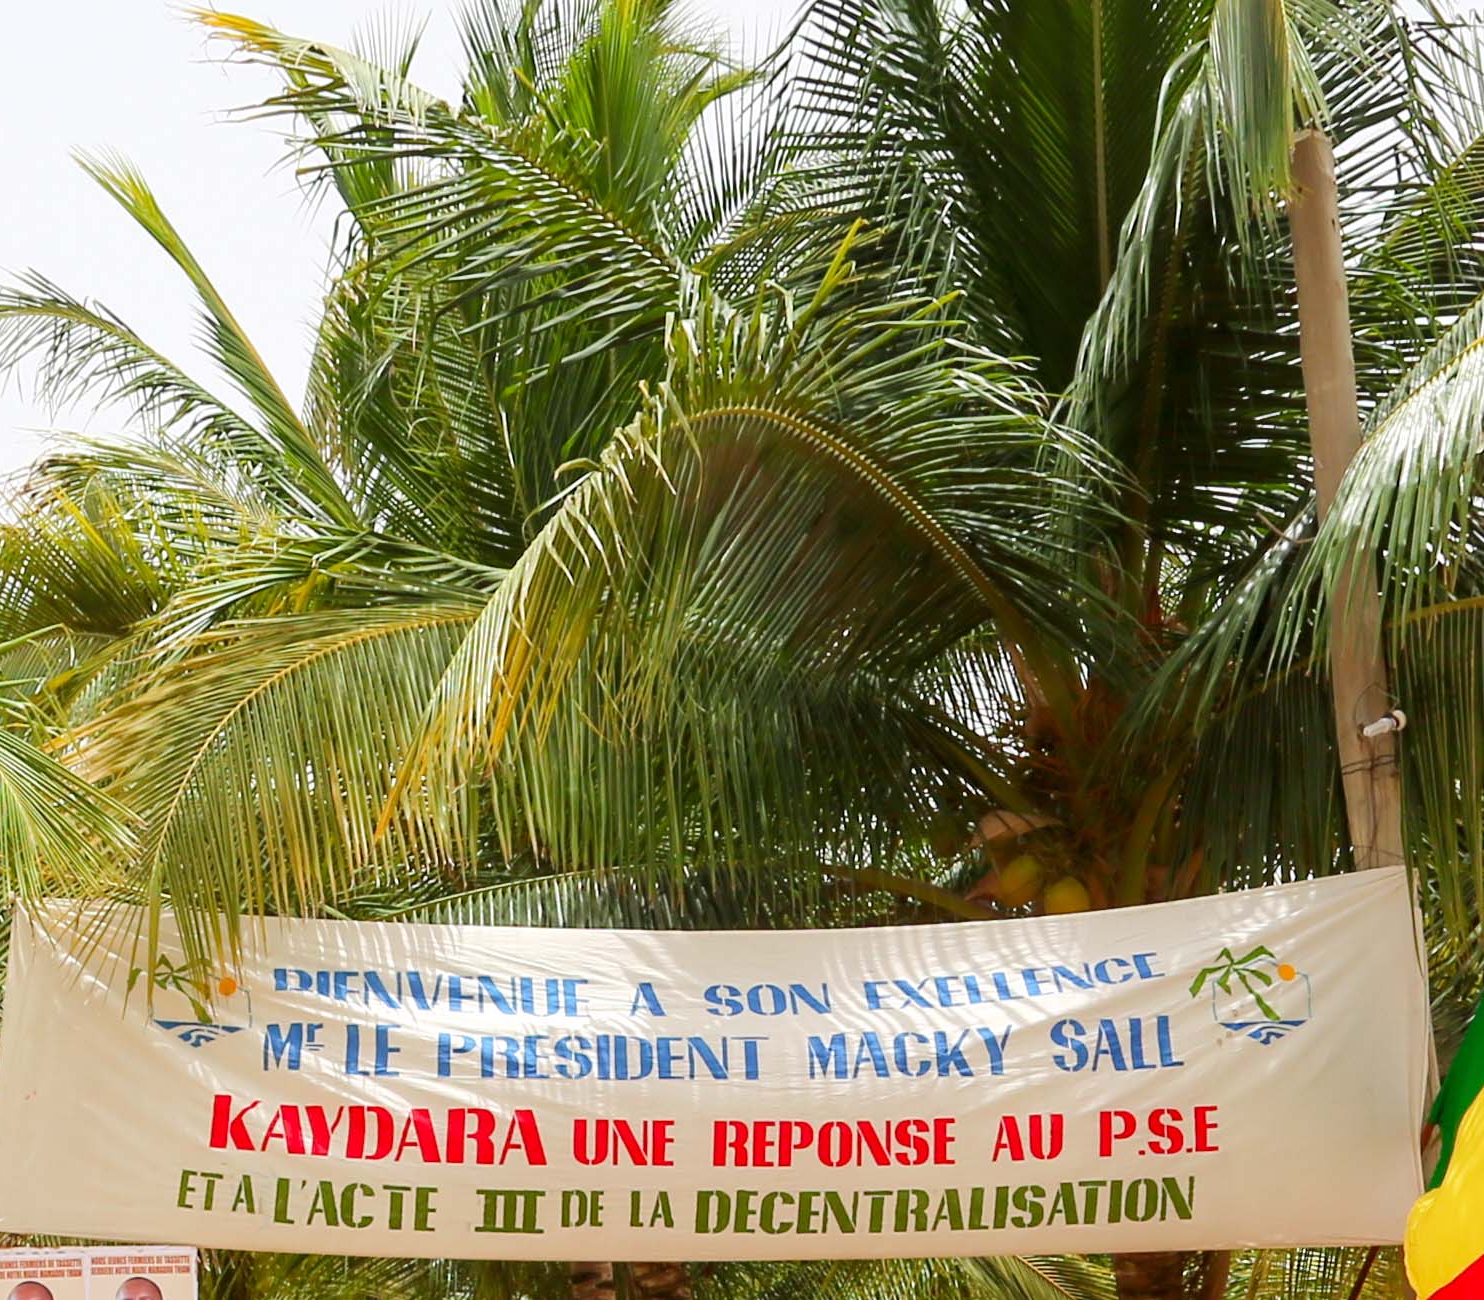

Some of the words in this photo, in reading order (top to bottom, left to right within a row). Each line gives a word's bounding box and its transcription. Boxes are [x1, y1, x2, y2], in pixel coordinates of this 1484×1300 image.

[630, 981, 668, 1019] A
[703, 983, 834, 1017] SON
[863, 952, 1167, 1011] EXELLENCE
[343, 1023, 401, 1078] LE
[436, 1030, 770, 1083] PRESIDENT
[806, 1023, 1013, 1081] MACKY
[1051, 1014, 1186, 1073] SALL
[209, 1094, 548, 1166] KAYDARA
[573, 1119, 676, 1167] UNE
[712, 1117, 957, 1168] REPONSE
[991, 1113, 1066, 1163] AU
[1098, 1105, 1220, 1158] P.S.E
[178, 1169, 223, 1209] ET
[232, 1174, 255, 1211] A
[273, 1177, 438, 1231] L'ACTE
[476, 1189, 546, 1233] III
[561, 1189, 603, 1227] DE
[630, 1190, 675, 1226] LA
[696, 1177, 1194, 1233] DECENTRALISATION
